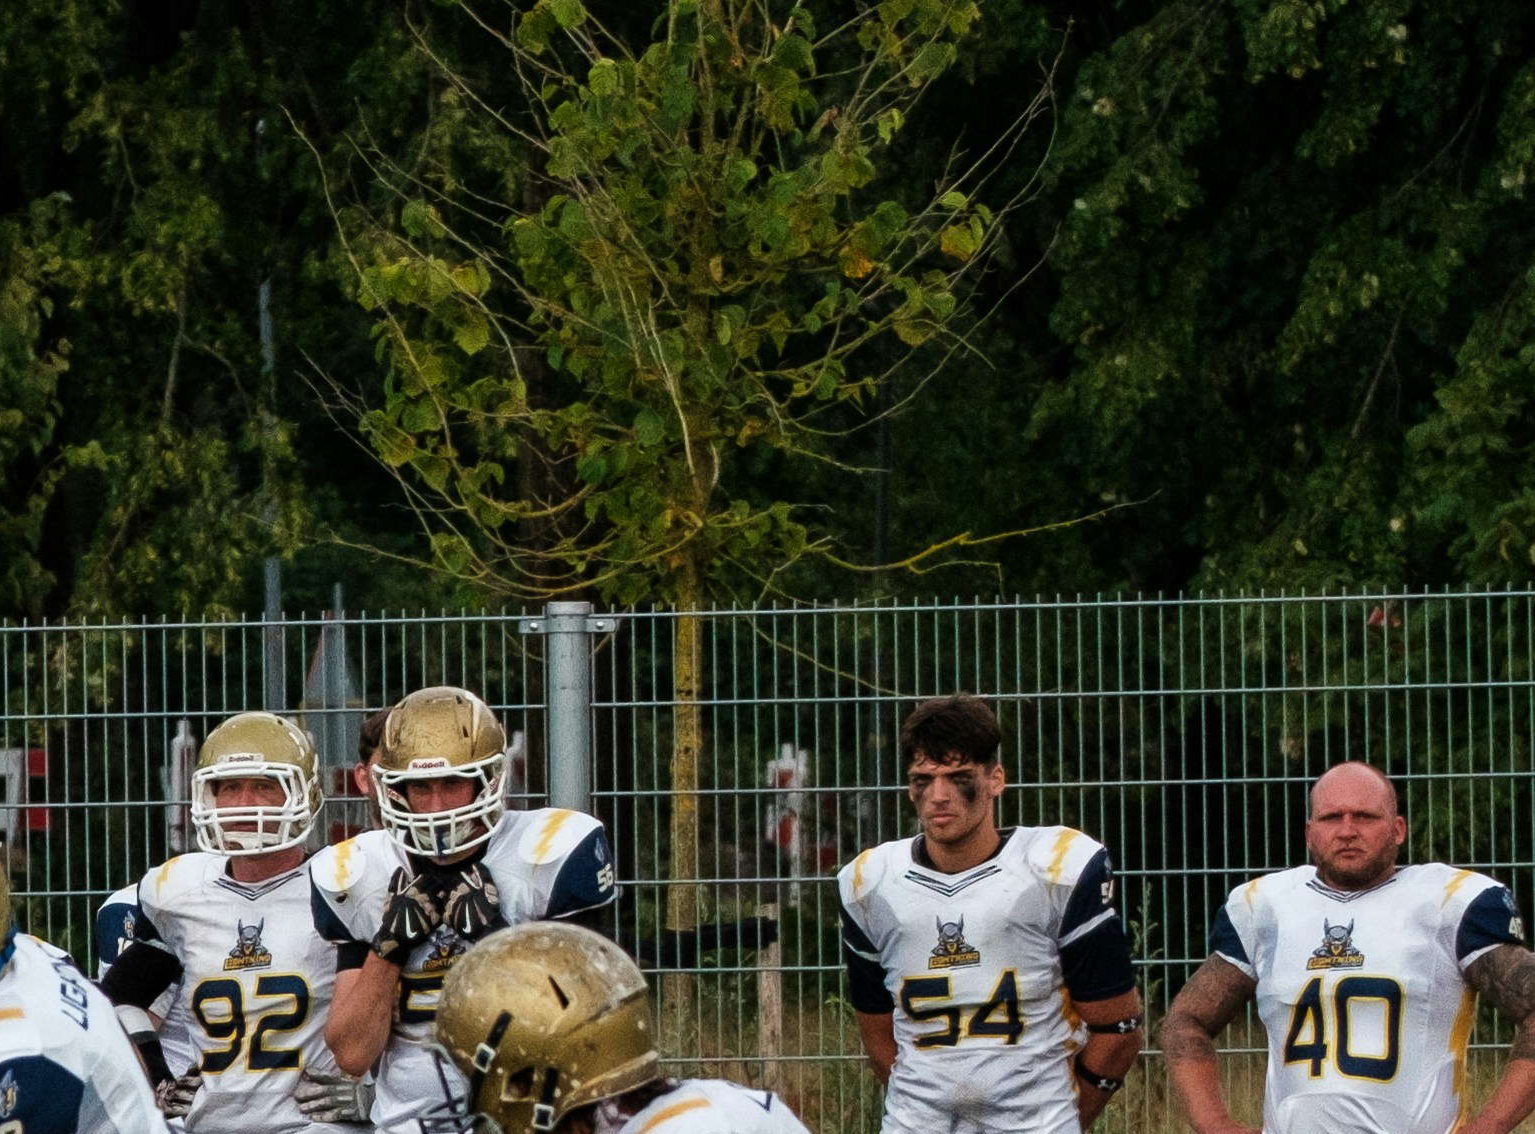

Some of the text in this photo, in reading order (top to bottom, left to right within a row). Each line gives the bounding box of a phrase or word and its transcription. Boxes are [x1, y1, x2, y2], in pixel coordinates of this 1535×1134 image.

[192, 971, 312, 1075] 92
[898, 967, 1025, 1048] 54
[1283, 975, 1406, 1085] 40
